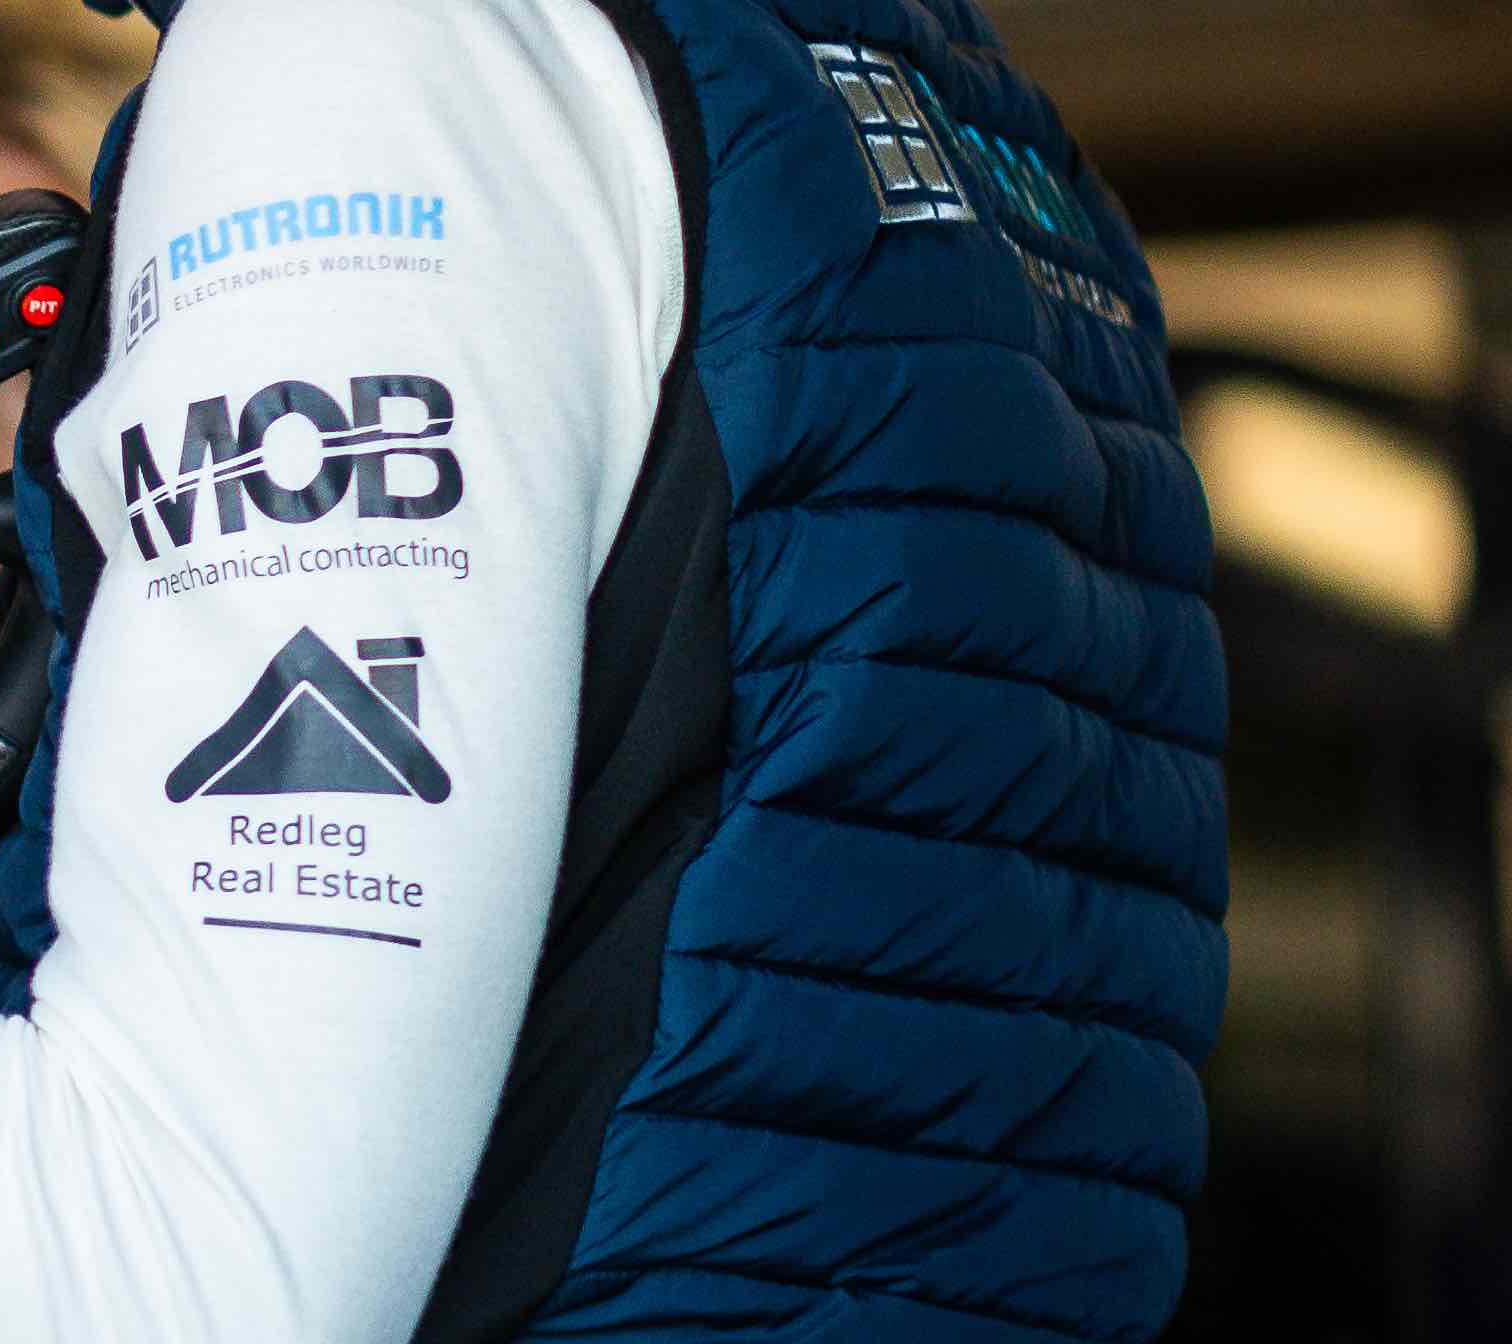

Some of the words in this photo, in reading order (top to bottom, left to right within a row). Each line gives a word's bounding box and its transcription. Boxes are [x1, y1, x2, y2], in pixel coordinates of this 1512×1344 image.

[168, 192, 445, 281] RUTRONIK
[29, 300, 58, 314] PIT
[173, 259, 312, 312] ELECTRONICS
[319, 255, 447, 275] WORLDWIDE
[120, 374, 464, 562] MOB
[146, 544, 291, 600] mechanical
[299, 537, 471, 580] contracting
[230, 814, 367, 857] Redleg
[192, 861, 274, 894] Real
[296, 864, 424, 908] Estate
